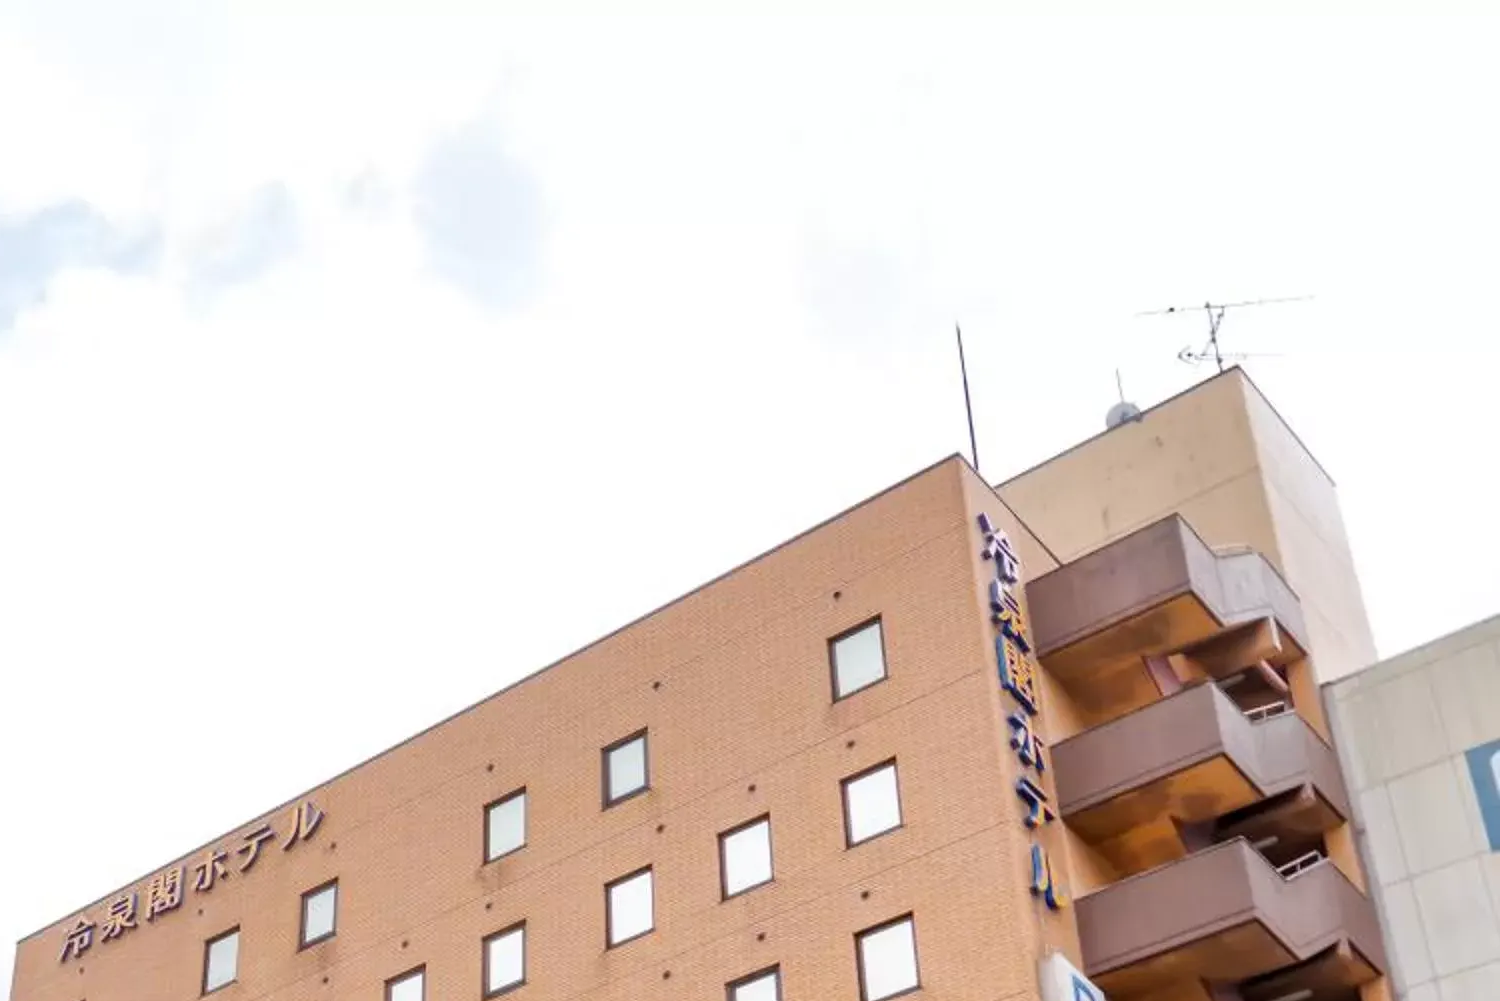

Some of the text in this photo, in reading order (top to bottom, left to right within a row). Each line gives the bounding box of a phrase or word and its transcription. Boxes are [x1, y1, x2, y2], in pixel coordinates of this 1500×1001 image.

[58, 801, 326, 963] 冷泉閣ホテル
